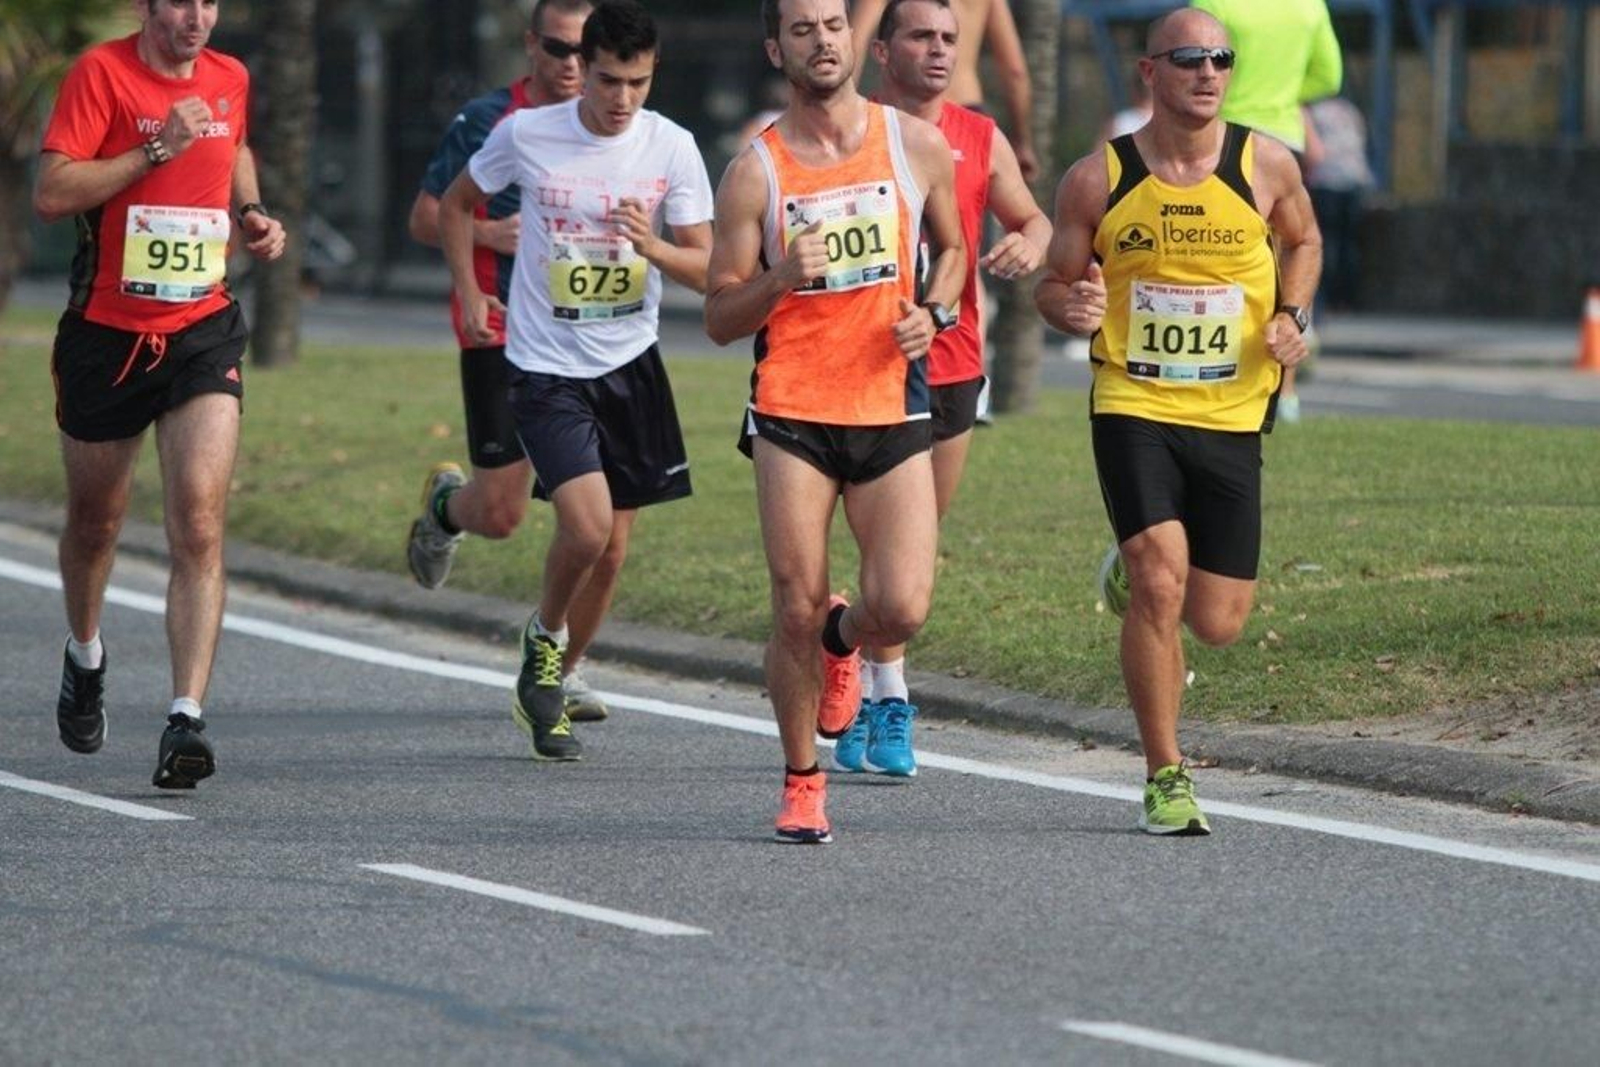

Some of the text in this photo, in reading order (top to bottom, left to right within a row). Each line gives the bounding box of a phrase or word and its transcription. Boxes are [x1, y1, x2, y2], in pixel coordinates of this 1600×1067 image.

[136, 118, 166, 136] VIG
[824, 223, 886, 263] 001
[1162, 221, 1245, 244] Iberisac
[147, 239, 206, 272] 951
[569, 266, 631, 295] 673
[1142, 322, 1228, 355] 1014
